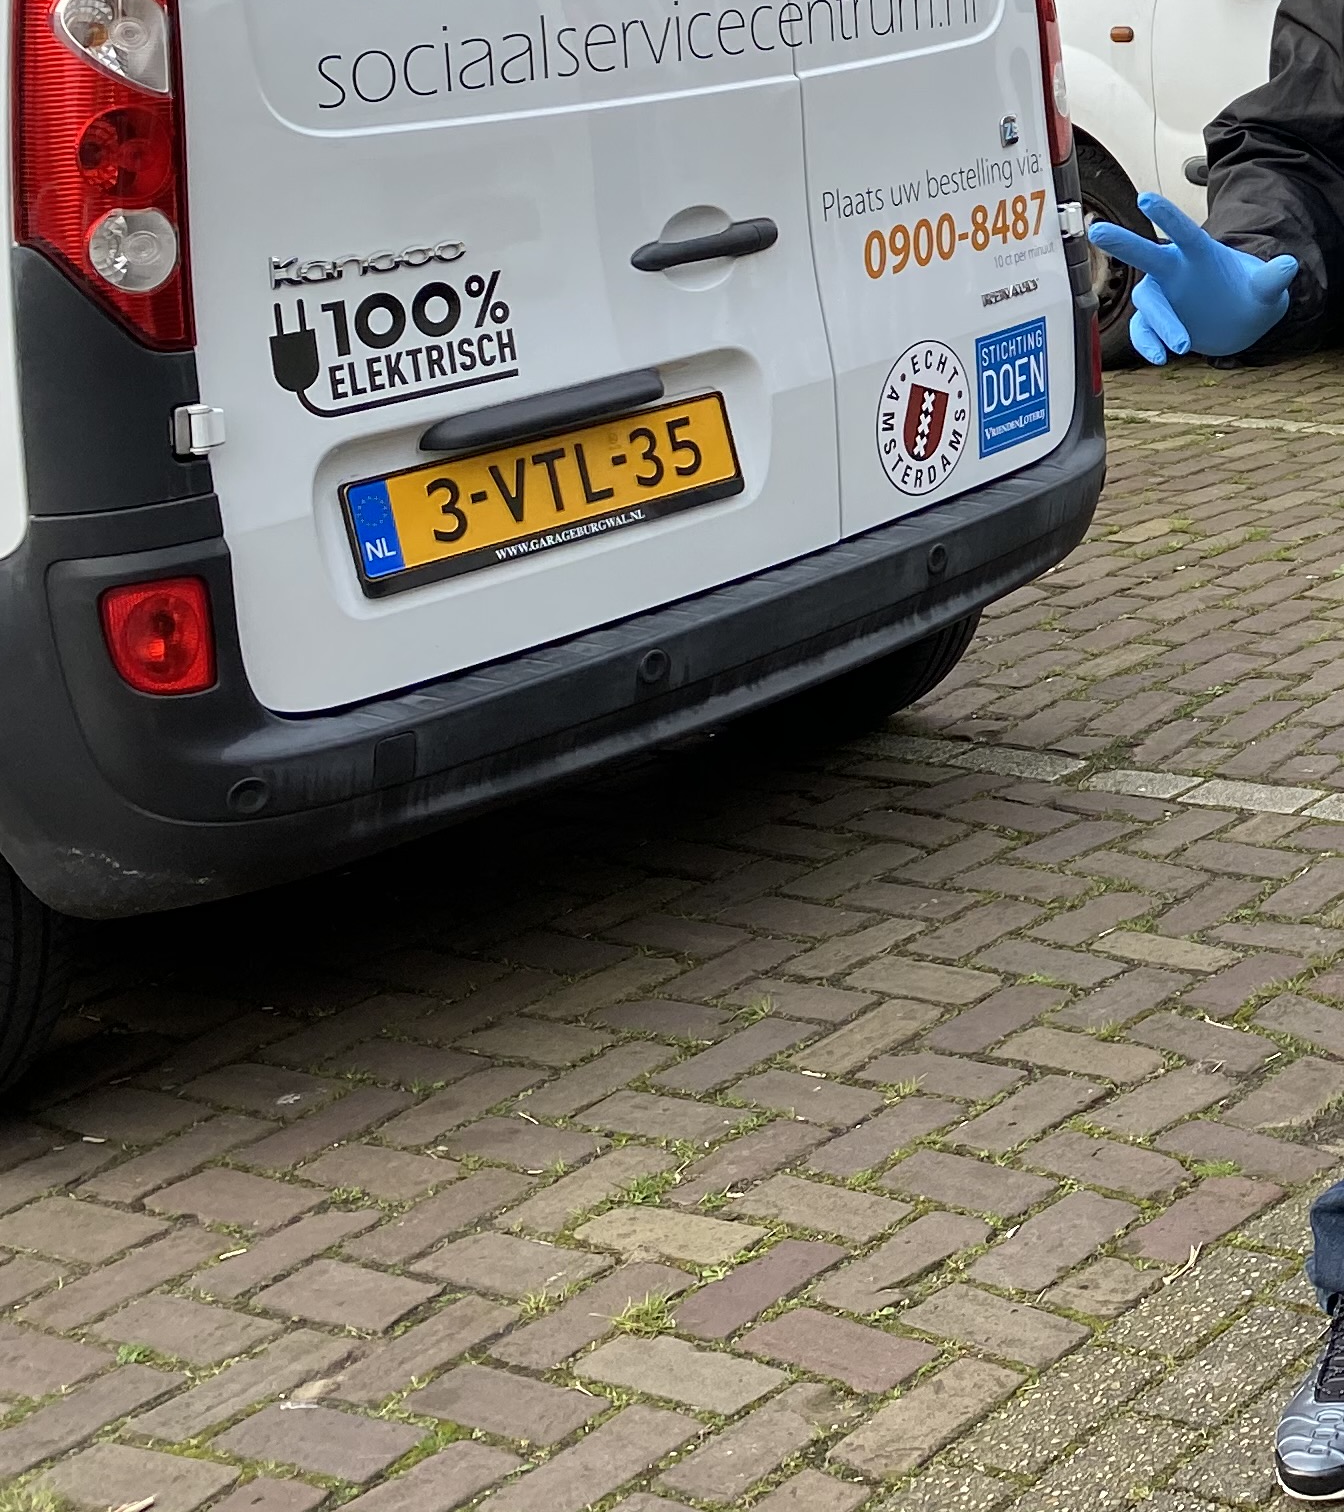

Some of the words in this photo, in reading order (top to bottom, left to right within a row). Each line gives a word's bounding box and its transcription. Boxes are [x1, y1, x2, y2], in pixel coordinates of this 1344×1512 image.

[822, 186, 885, 222] Plaats
[889, 180, 920, 205] uw
[926, 158, 1013, 202] bestelling
[1016, 149, 1044, 178] via:
[864, 190, 1047, 280] 0900-8487
[320, 270, 510, 358] 100%
[981, 329, 1043, 367] STICHTING
[327, 328, 519, 402] ELEKTRISCH
[911, 349, 960, 385] ECHT
[982, 351, 1045, 414] DOEN
[882, 385, 966, 489] AMSTERDAMS
[425, 416, 702, 544] 3-VTL-35
[365, 538, 397, 563] NL
[495, 509, 646, 562] WWW.GARAGEBURGWAL.NL
